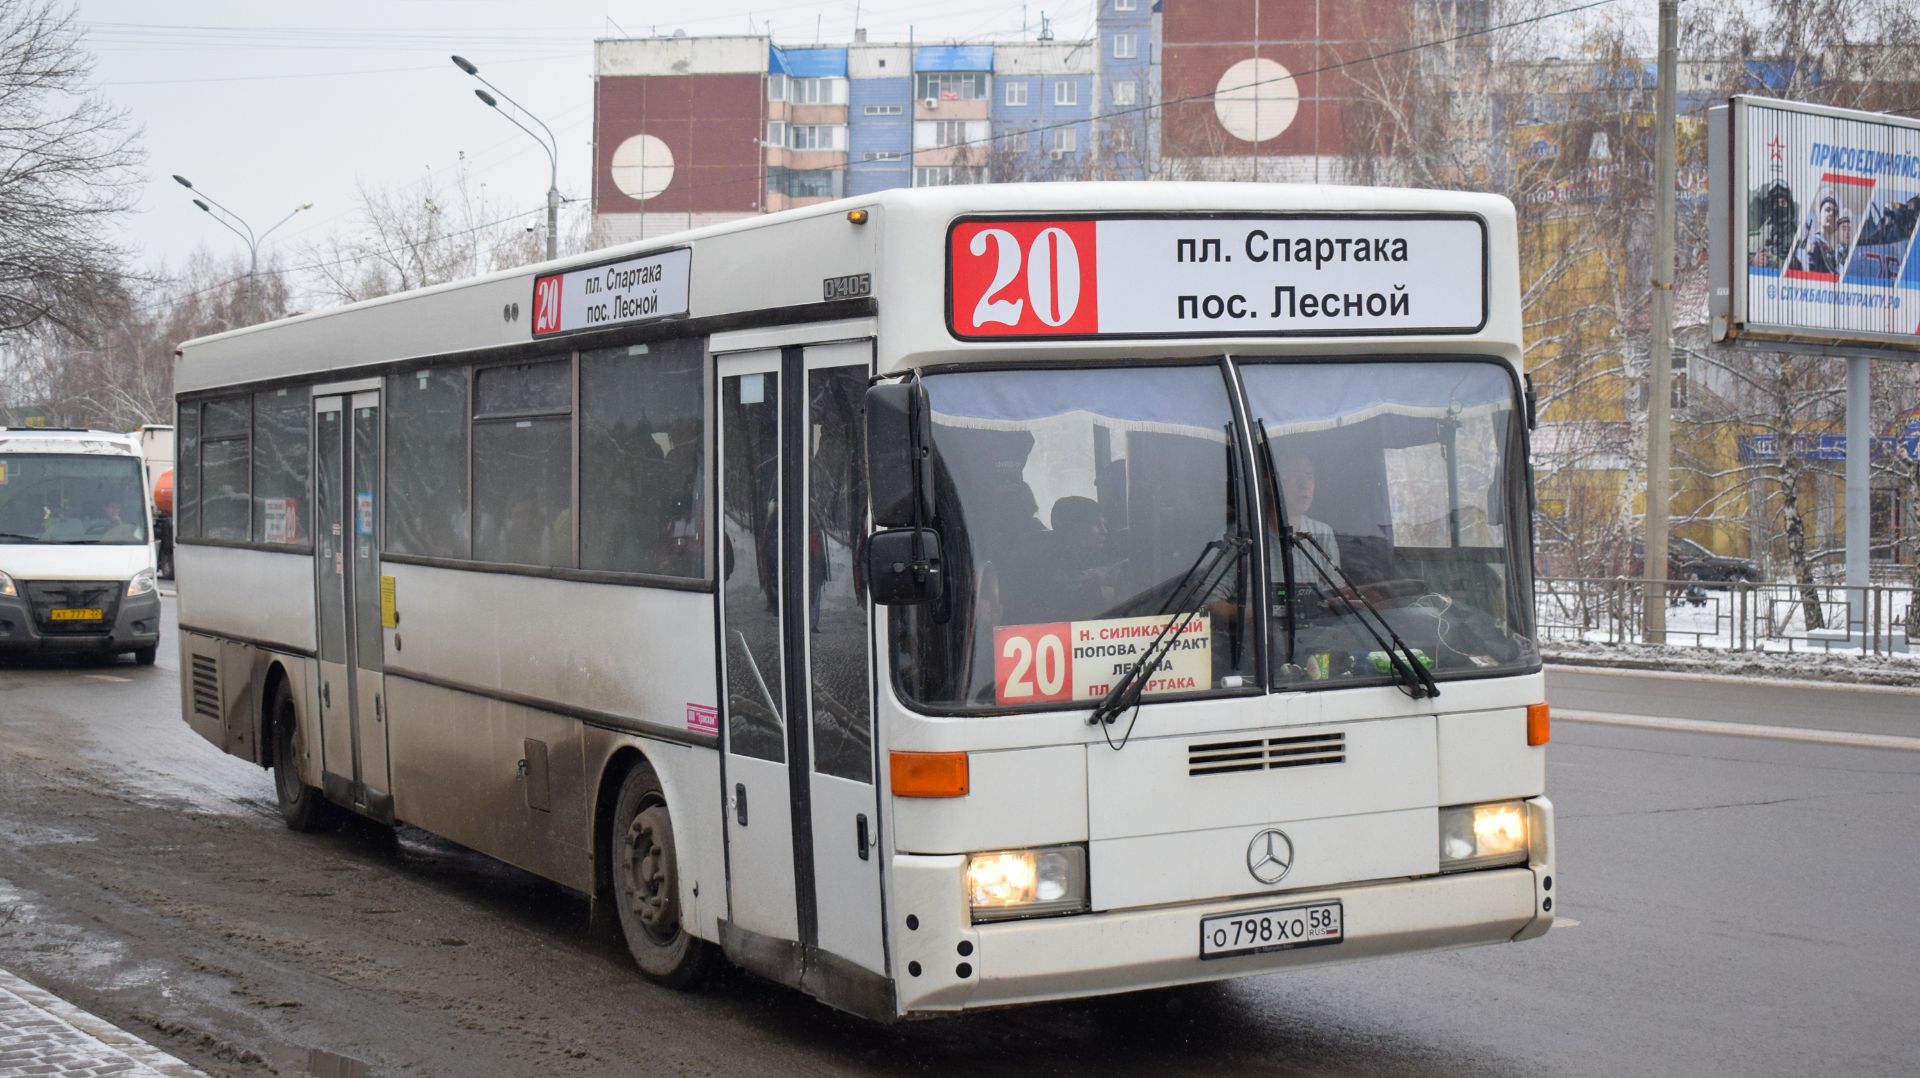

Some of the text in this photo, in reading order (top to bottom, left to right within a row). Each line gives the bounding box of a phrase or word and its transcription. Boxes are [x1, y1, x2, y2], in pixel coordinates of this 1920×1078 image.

[1810, 142, 1920, 179] ПРИСОЕДИНЯЙС
[1176, 229, 1409, 270] пл. Спартака
[585, 263, 662, 295] пл. Спартака
[969, 226, 1081, 329] 20
[536, 278, 559, 331] 20
[587, 289, 658, 324] пос. Лесной
[1177, 283, 1410, 320] пос. Лесной
[1073, 643, 1137, 660] ПОПОВА
[1079, 629, 1095, 642] Н.
[1003, 633, 1066, 699] 20
[1308, 927, 1327, 937] RUS
[1309, 908, 1332, 929] 58
